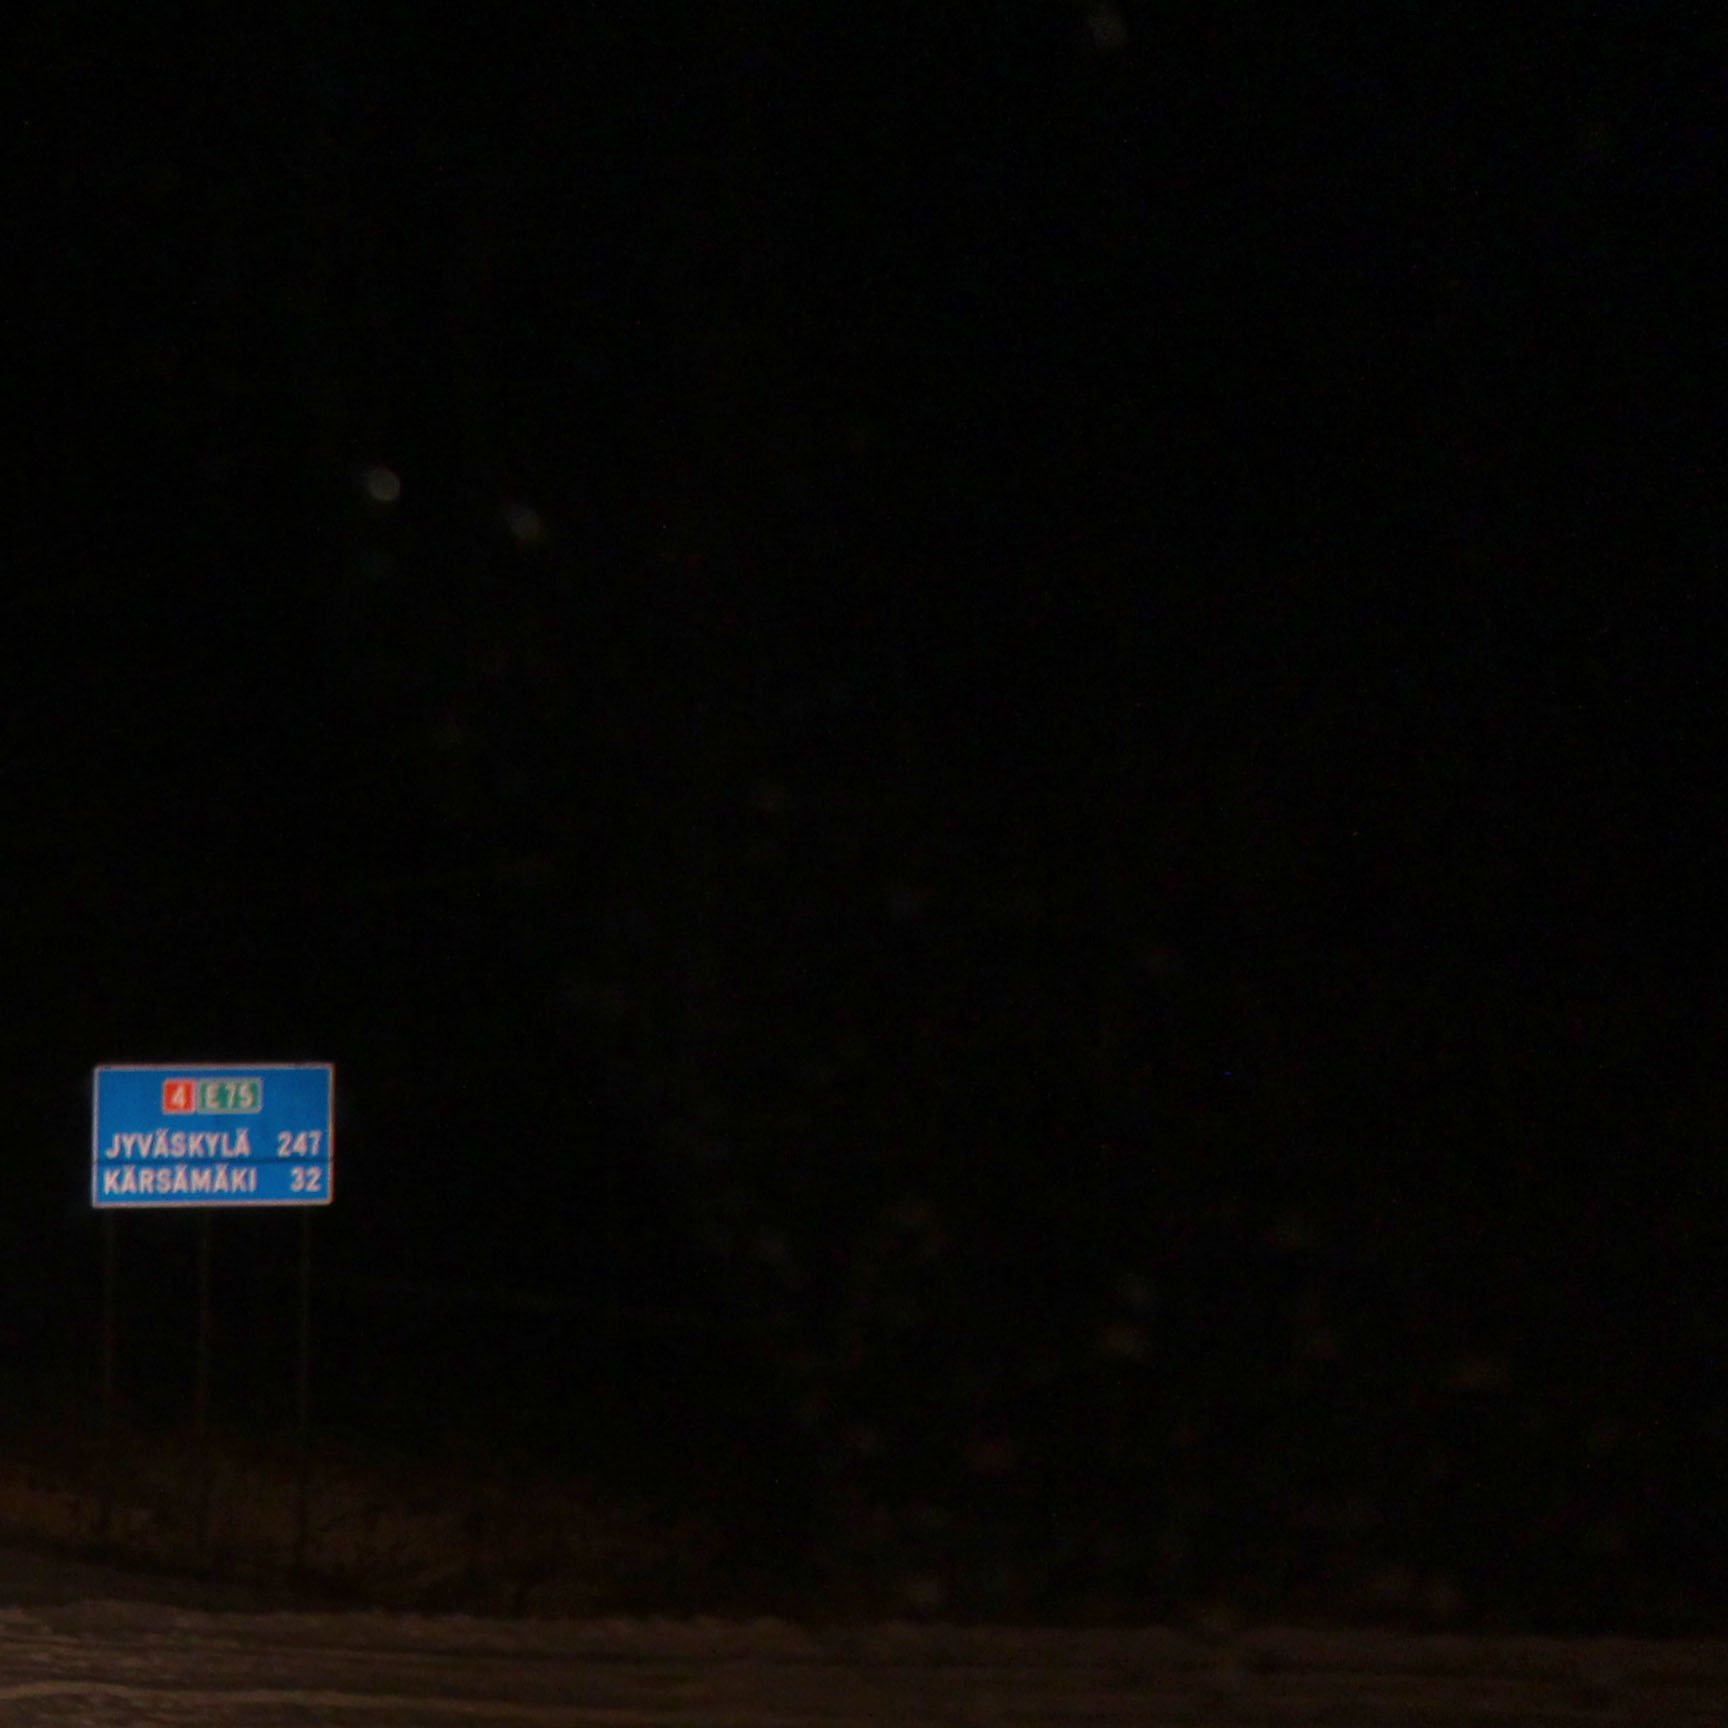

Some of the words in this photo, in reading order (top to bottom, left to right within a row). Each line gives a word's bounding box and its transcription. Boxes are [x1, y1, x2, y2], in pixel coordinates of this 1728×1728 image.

[170, 1084, 186, 1108] 4
[106, 1128, 252, 1159] JYVÄSKYLÄ
[277, 1130, 323, 1157] 247
[104, 1164, 258, 1194] KÄRSÄMÄKI
[290, 1166, 323, 1192] 32
